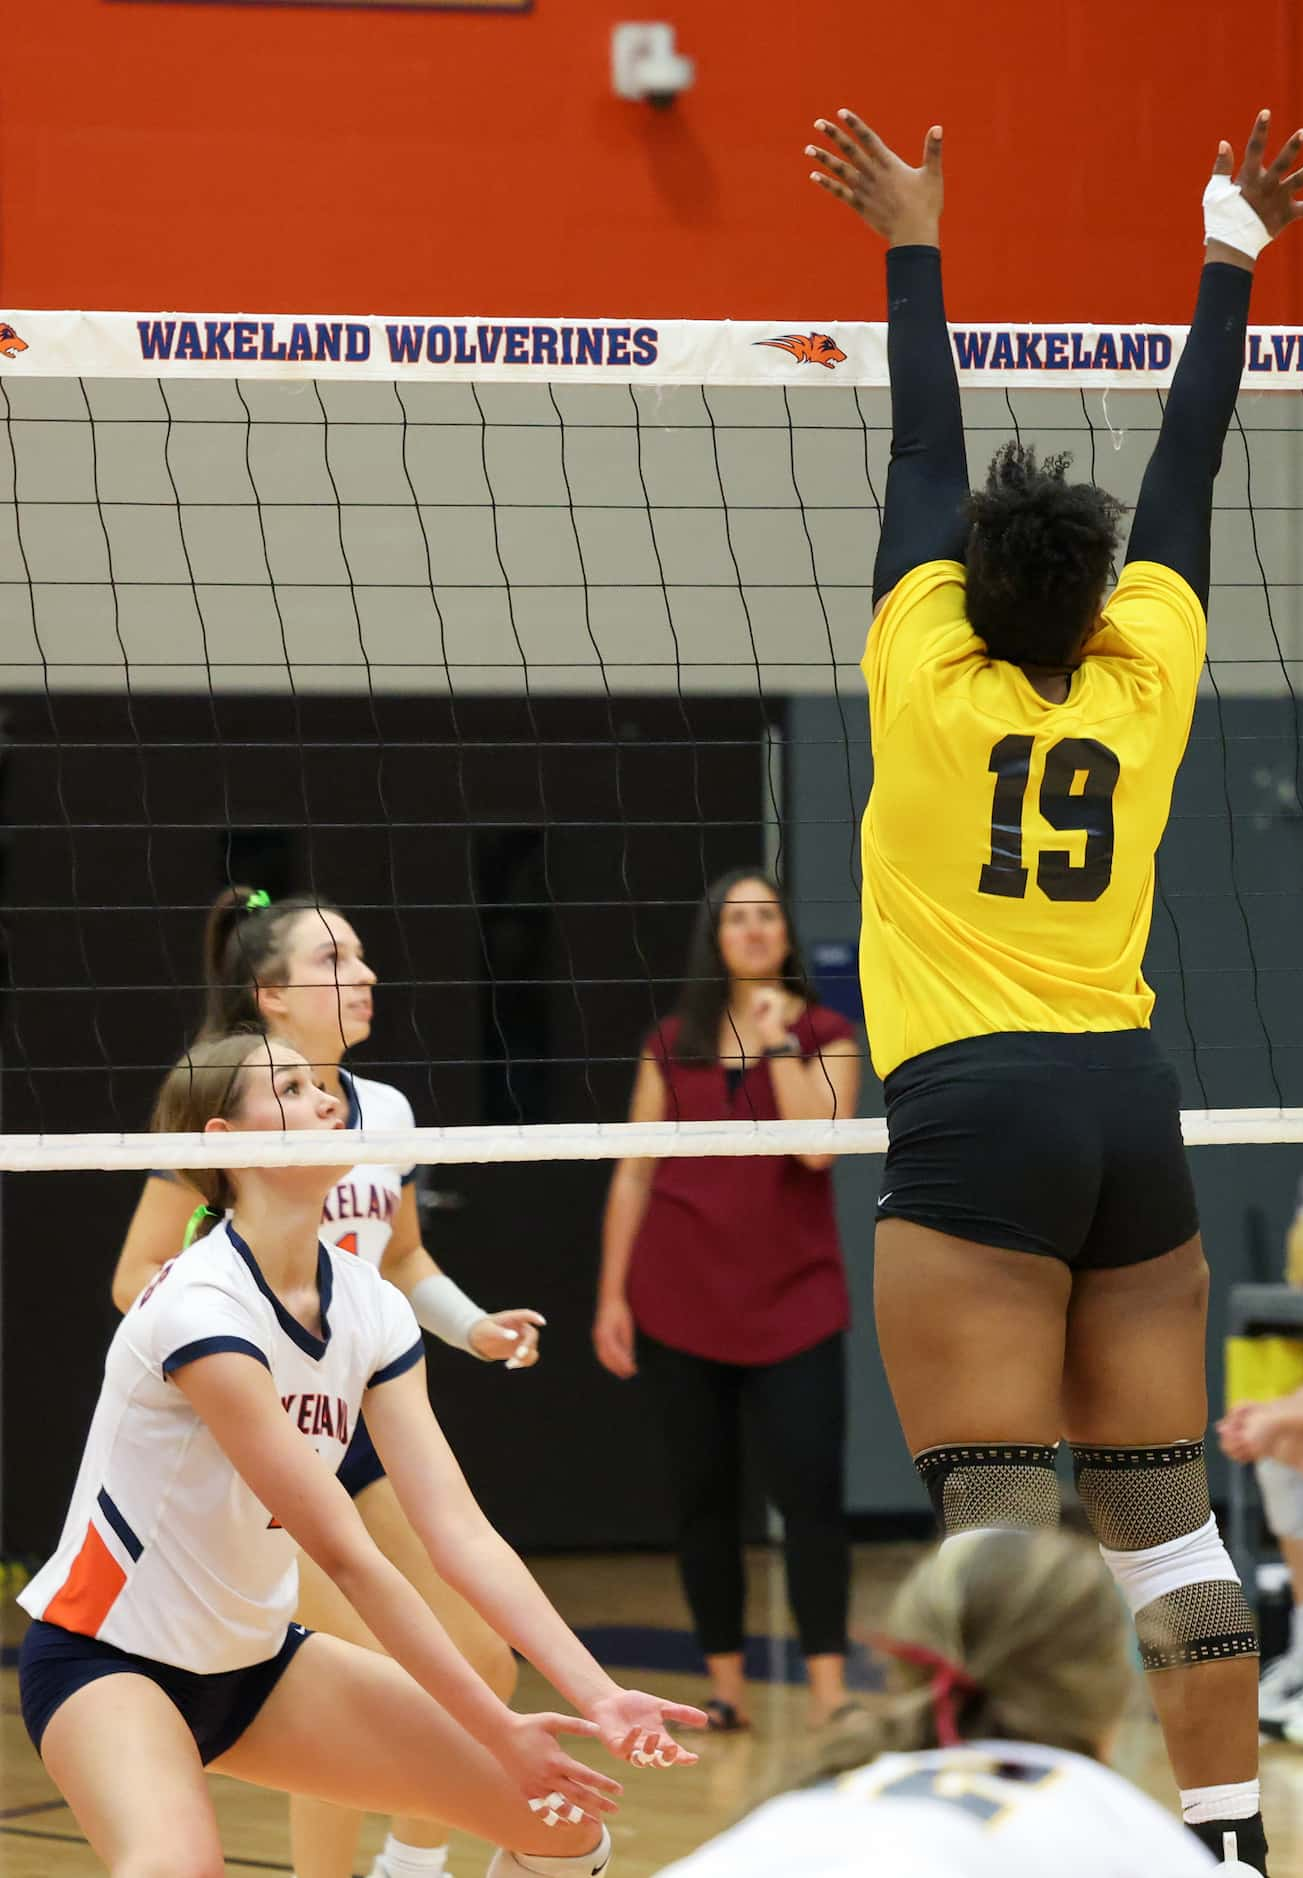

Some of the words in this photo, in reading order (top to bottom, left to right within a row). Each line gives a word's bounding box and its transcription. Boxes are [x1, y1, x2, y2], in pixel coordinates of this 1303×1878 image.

[137, 320, 371, 362] WAKELAND
[385, 323, 658, 366] WOLVERINES
[953, 331, 1172, 370] WAKELAND
[978, 733, 1121, 902] 19
